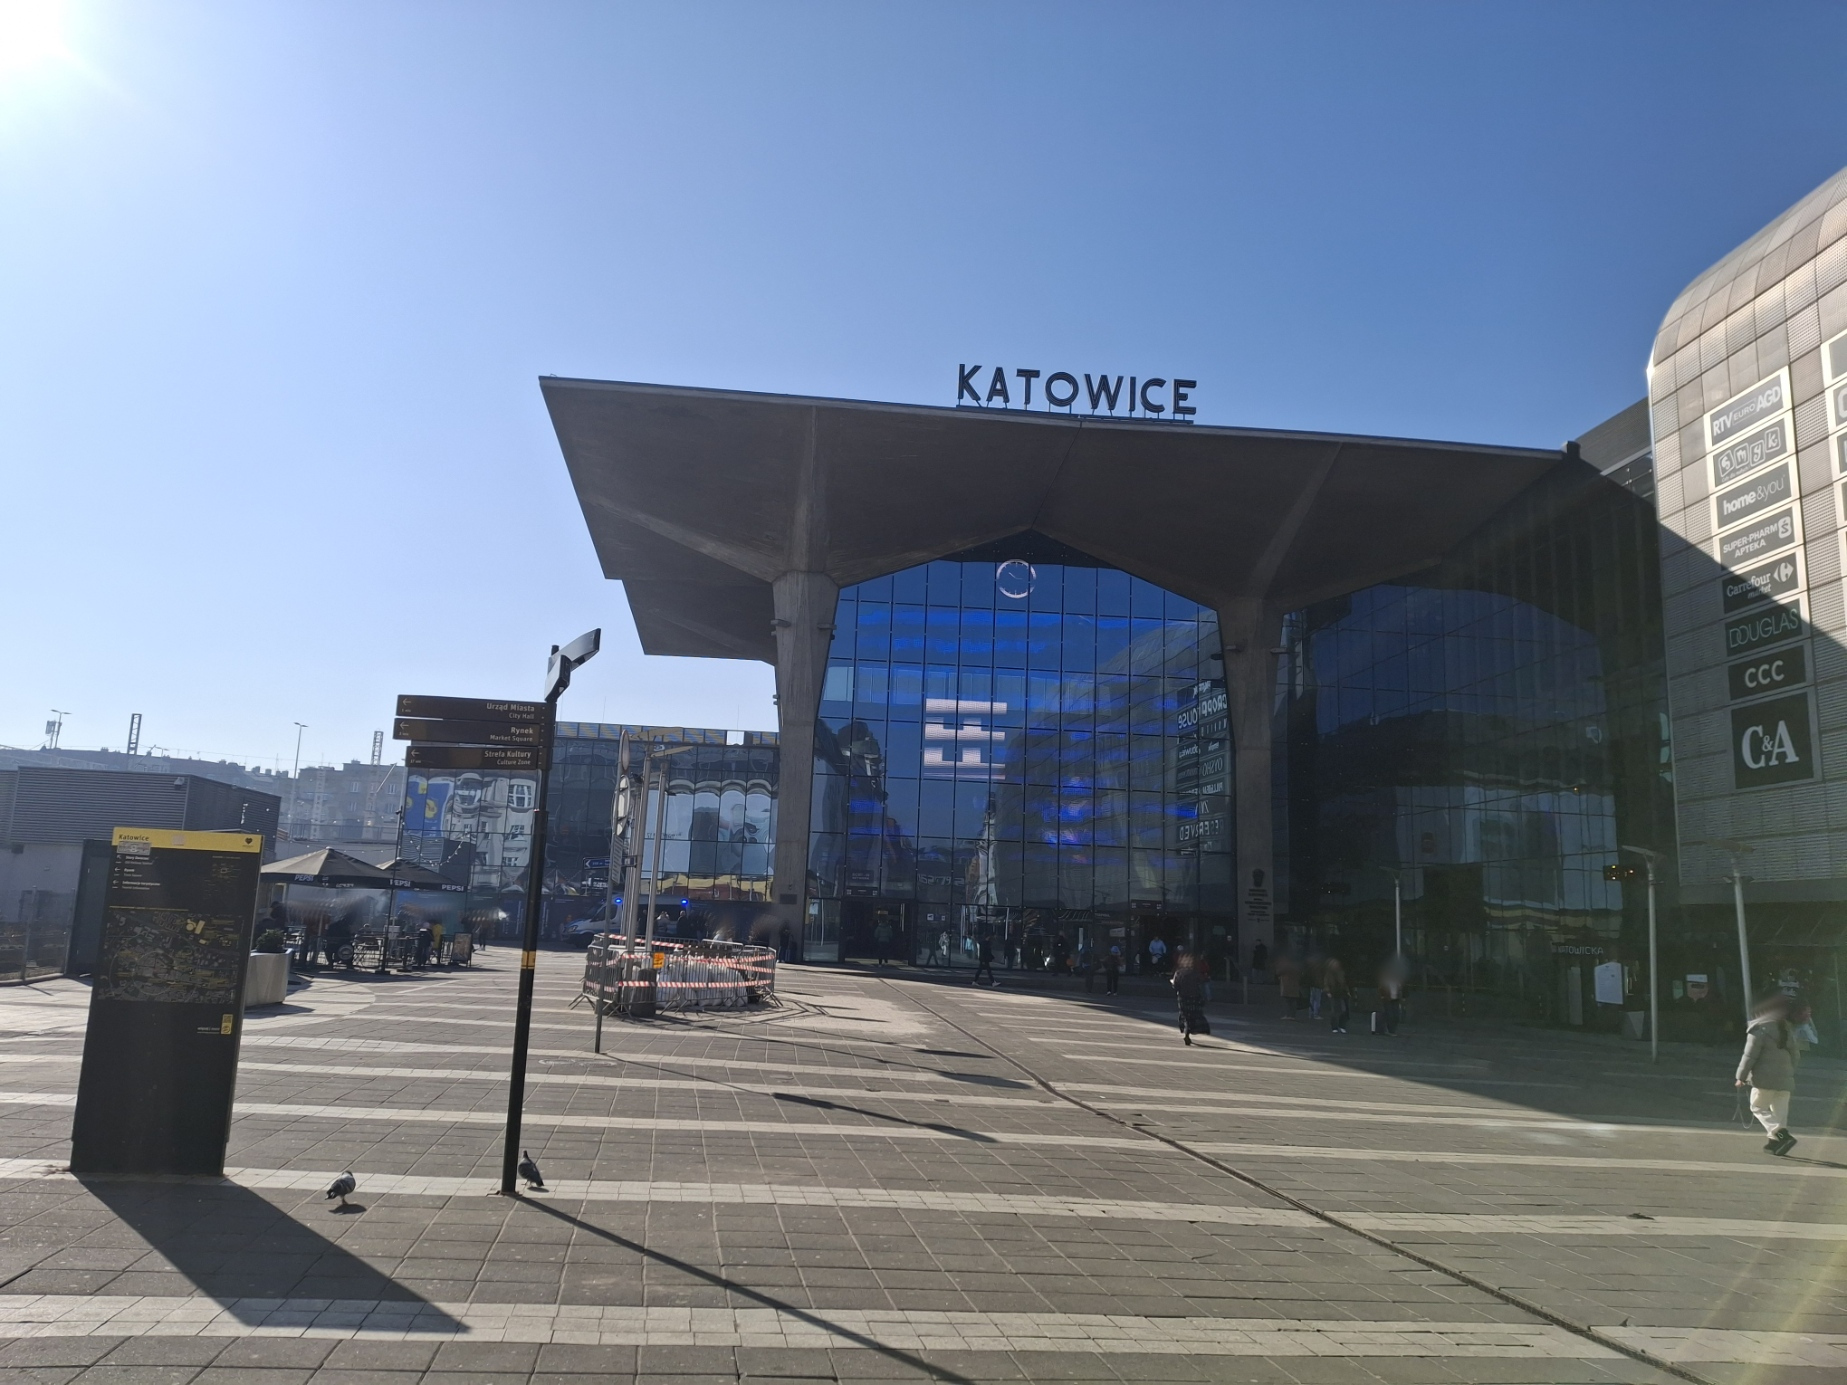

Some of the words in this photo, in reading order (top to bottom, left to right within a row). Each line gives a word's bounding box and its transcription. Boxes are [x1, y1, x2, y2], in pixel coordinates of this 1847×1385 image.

[958, 363, 1197, 415] KATOWICE
[1712, 412, 1734, 437] RTV
[1733, 401, 1756, 421] EURO
[1755, 386, 1781, 413] AGD
[1723, 474, 1786, 515] home&you
[1723, 523, 1778, 553] SUPER-PHARM
[1734, 539, 1766, 558] APTEKA
[1726, 572, 1771, 597] Carrefour
[1747, 584, 1772, 599] market
[1729, 609, 1799, 648] DOUGLAS
[1744, 660, 1785, 688] CCC
[486, 703, 508, 712] Urząd
[510, 704, 535, 712] Miasta
[508, 712, 521, 720] City
[510, 726, 534, 735] Rynek
[484, 750, 505, 758] Strefa
[507, 750, 532, 759] Kultury
[1741, 719, 1799, 769] C&A
[294, 874, 314, 882] PEPSI
[441, 884, 464, 892] PEPSI
